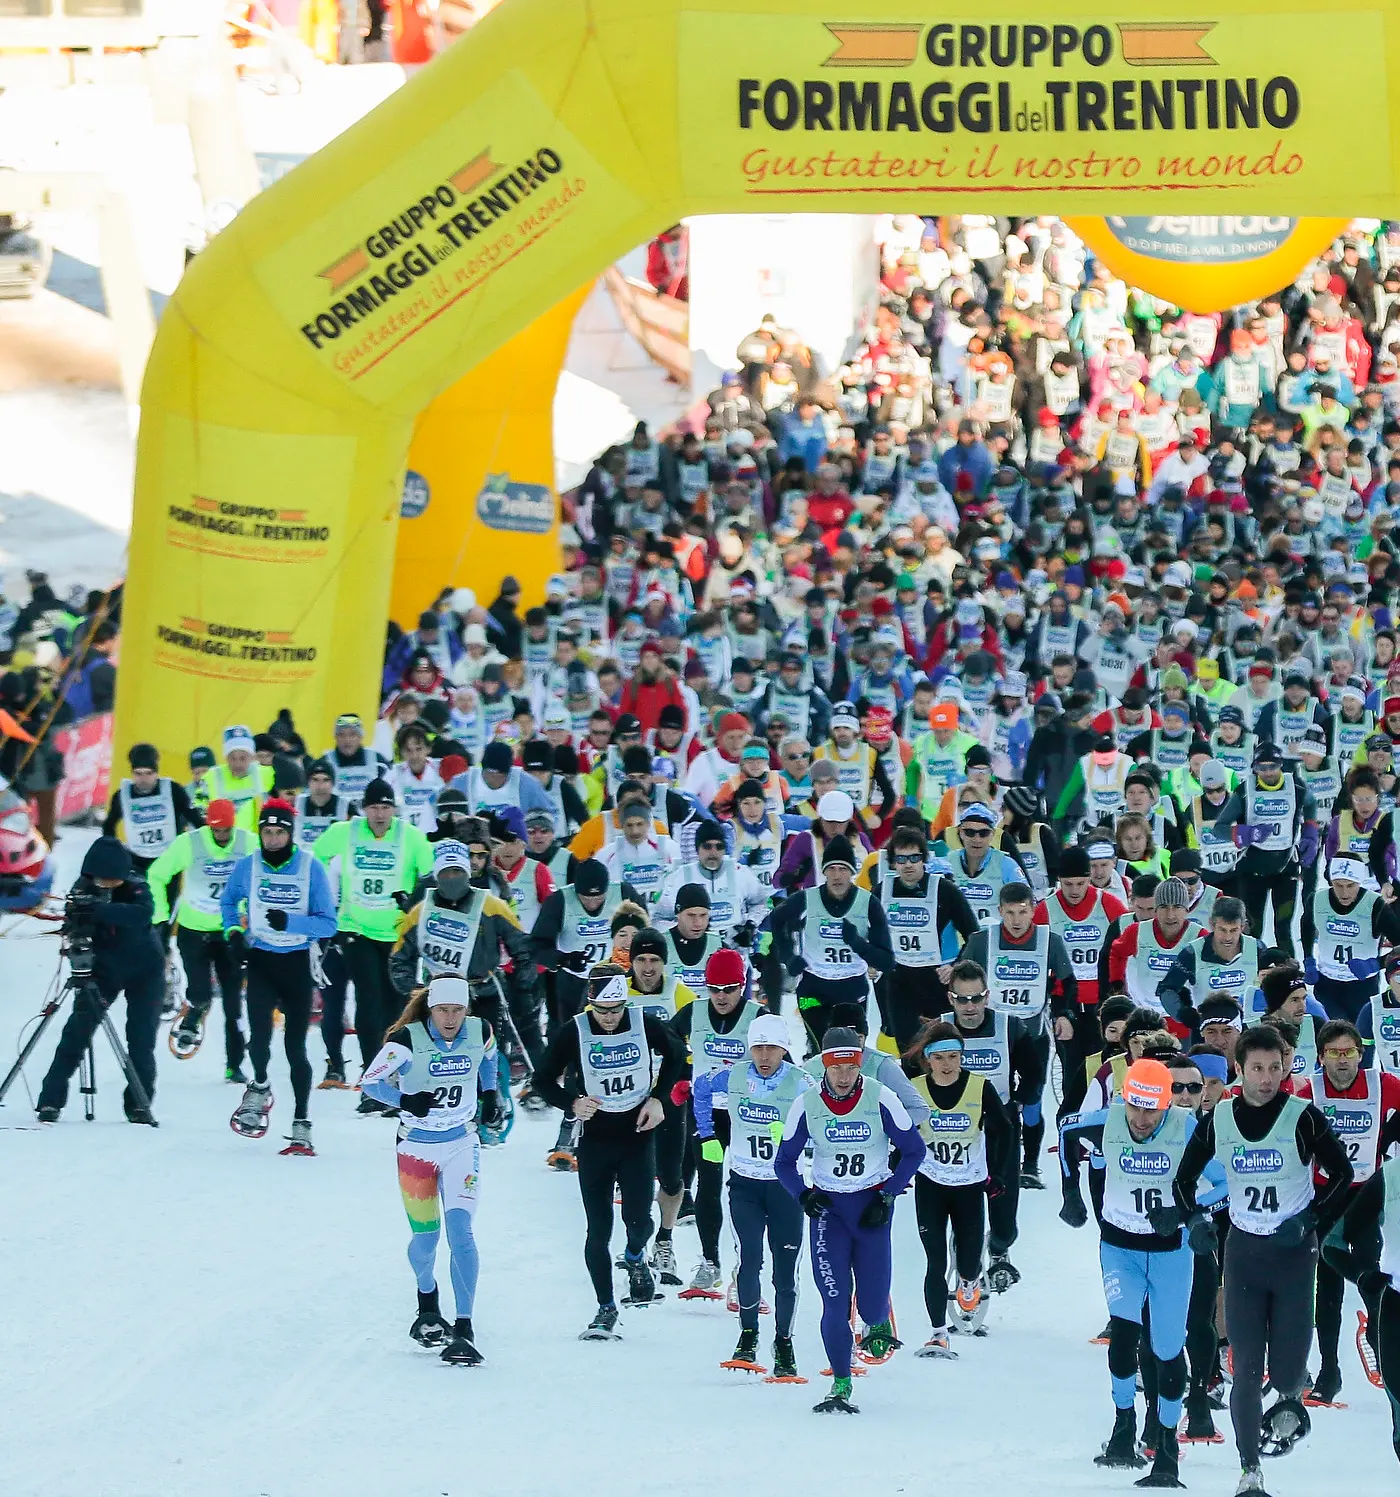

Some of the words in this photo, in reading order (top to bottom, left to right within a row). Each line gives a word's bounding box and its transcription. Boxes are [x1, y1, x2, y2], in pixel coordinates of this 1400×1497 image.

[925, 24, 1113, 67] GRUPPO
[738, 79, 1011, 133] FORMAGGI
[1015, 103, 1050, 133] del
[1046, 75, 1301, 131] TRENTINO
[741, 146, 956, 183] Gustatevi
[966, 145, 1000, 180] il
[1014, 152, 1142, 180] nostro
[1157, 139, 1304, 176] mondo
[366, 185, 457, 259] GRUPPO
[301, 244, 439, 350] FORMAGGI
[437, 147, 564, 250] TRENTINO
[219, 502, 278, 521] GRUPPO
[251, 523, 330, 542] TRENTINO
[207, 623, 264, 643] GRUPPO
[140, 829, 164, 846] 124
[355, 855, 395, 870] Melinda
[363, 879, 384, 895] 88
[888, 910, 929, 924] Melinda
[1064, 927, 1101, 941] Melinda
[1327, 922, 1361, 936] Melinda
[900, 936, 921, 951] 94
[825, 947, 852, 964] 36
[1071, 948, 1098, 965] 60
[995, 963, 1040, 978] Melinda
[1208, 971, 1246, 986] Melinda
[1001, 989, 1030, 1006] 134
[588, 1047, 642, 1066] Melinda
[704, 1041, 745, 1056] Melinda
[428, 1057, 471, 1072] Melinda
[601, 1074, 635, 1096] 144
[434, 1085, 463, 1108] 29
[738, 1104, 781, 1122] Melinda
[931, 1114, 972, 1130] Melinda
[1327, 1112, 1372, 1131] Melinda
[825, 1123, 871, 1140] Melinda
[747, 1135, 774, 1161] 15
[833, 1153, 866, 1177] 38
[1119, 1152, 1171, 1170] Melinda
[1231, 1150, 1283, 1168] Melinda
[1130, 1188, 1162, 1213] 16
[1244, 1186, 1280, 1213] 24
[818, 1256, 840, 1298] LONATO
